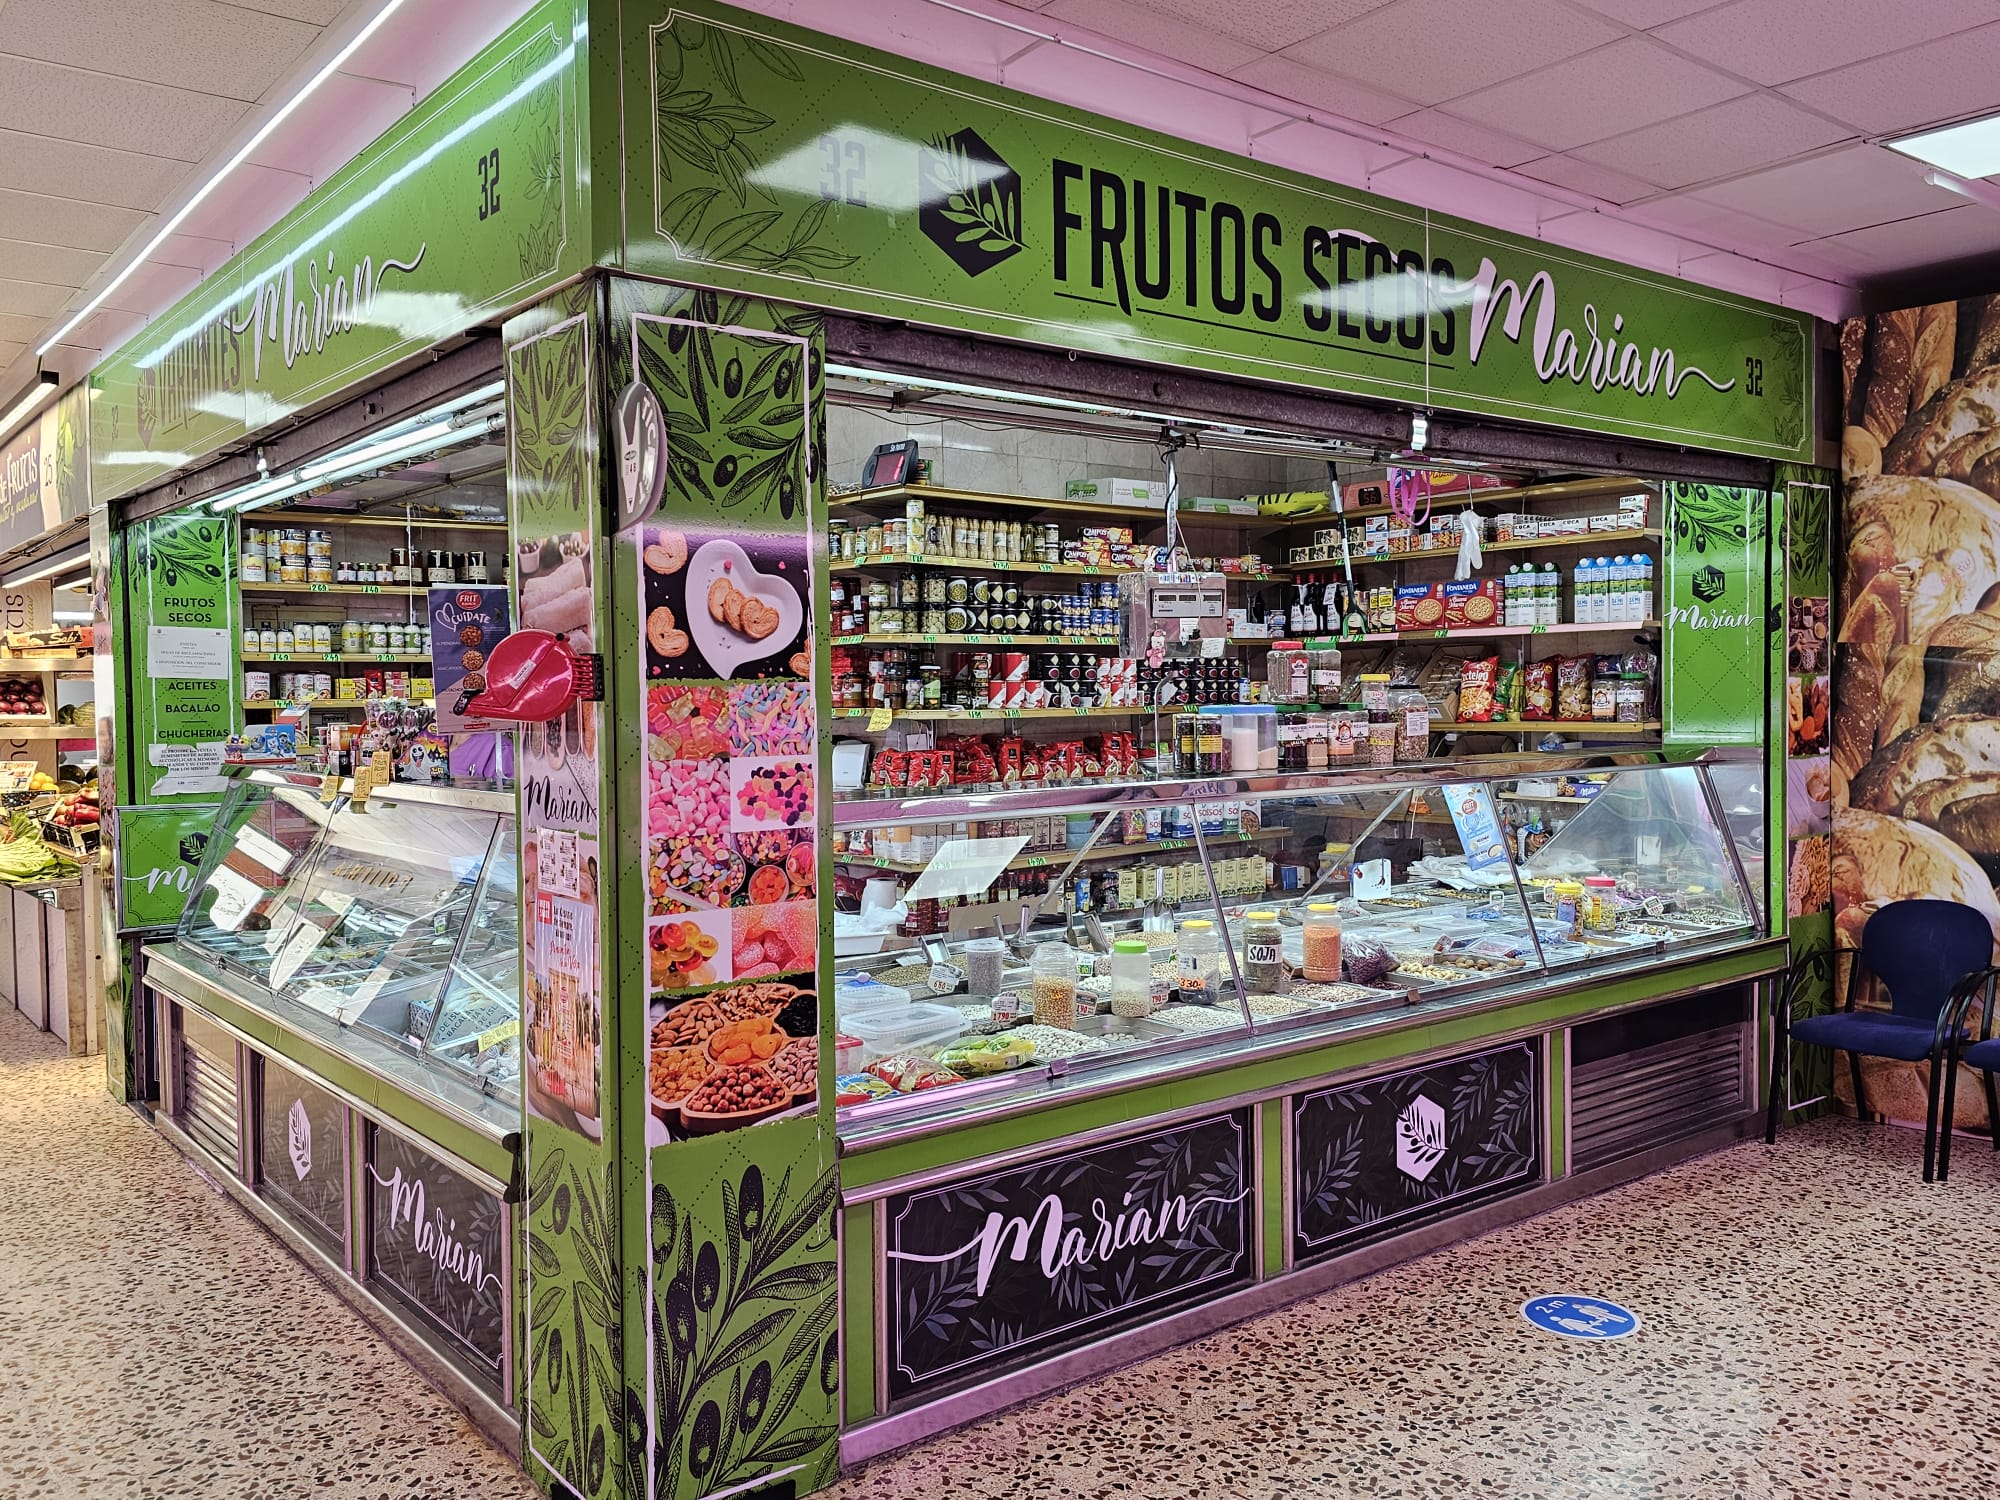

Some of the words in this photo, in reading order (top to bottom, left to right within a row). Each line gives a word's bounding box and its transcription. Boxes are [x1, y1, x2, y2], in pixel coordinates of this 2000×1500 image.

[818, 134, 867, 208] 32
[477, 147, 501, 221] 32
[1051, 157, 1283, 323] FRUTOS
[1303, 224, 1456, 357] SECOS
[1440, 250, 1736, 401] Marian
[1744, 356, 1764, 397] 32
[222, 242, 426, 382] Marian
[1398, 586, 1428, 595] FONTANEDA
[1446, 583, 1478, 593] FONTANEDA
[163, 597, 216, 608] FRUTOS
[460, 594, 478, 603] FRIT
[168, 612, 213, 623] SECOS
[1664, 604, 1764, 631] Marian
[168, 680, 217, 691] ACEITES
[165, 703, 221, 714] BACALAO
[158, 728, 229, 740] CHUCHERIAS
[523, 774, 598, 823] Marian
[1249, 946, 1276, 963] SOJA
[366, 1163, 503, 1292] Marian
[887, 1188, 1254, 1297] Marian
[1535, 1304, 1554, 1314] 2
[1549, 1299, 1568, 1309] m
